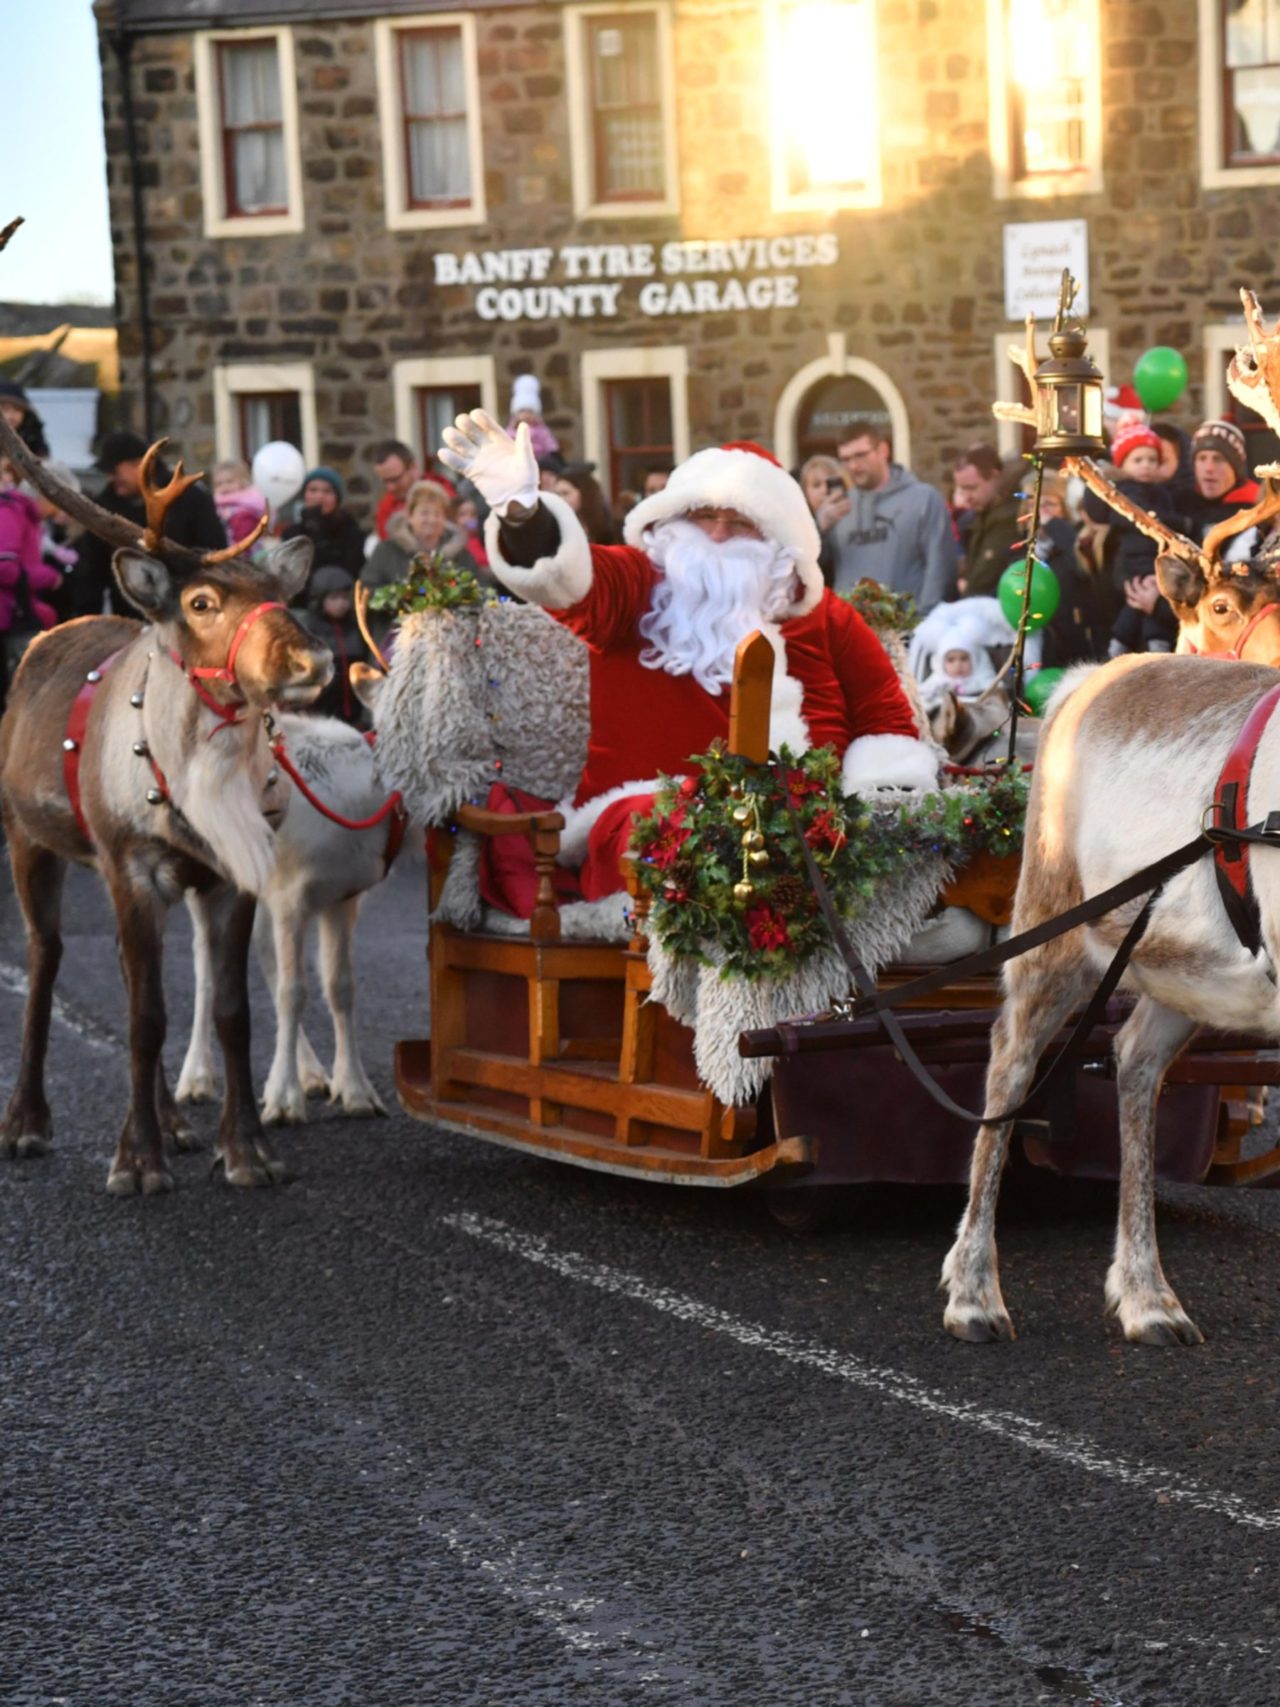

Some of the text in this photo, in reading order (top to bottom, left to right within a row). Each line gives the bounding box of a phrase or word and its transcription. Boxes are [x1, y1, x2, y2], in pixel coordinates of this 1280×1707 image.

[434, 234, 840, 285] BANFF TYRE SERVICES
[475, 276, 799, 320] COUNTY GARAGE
